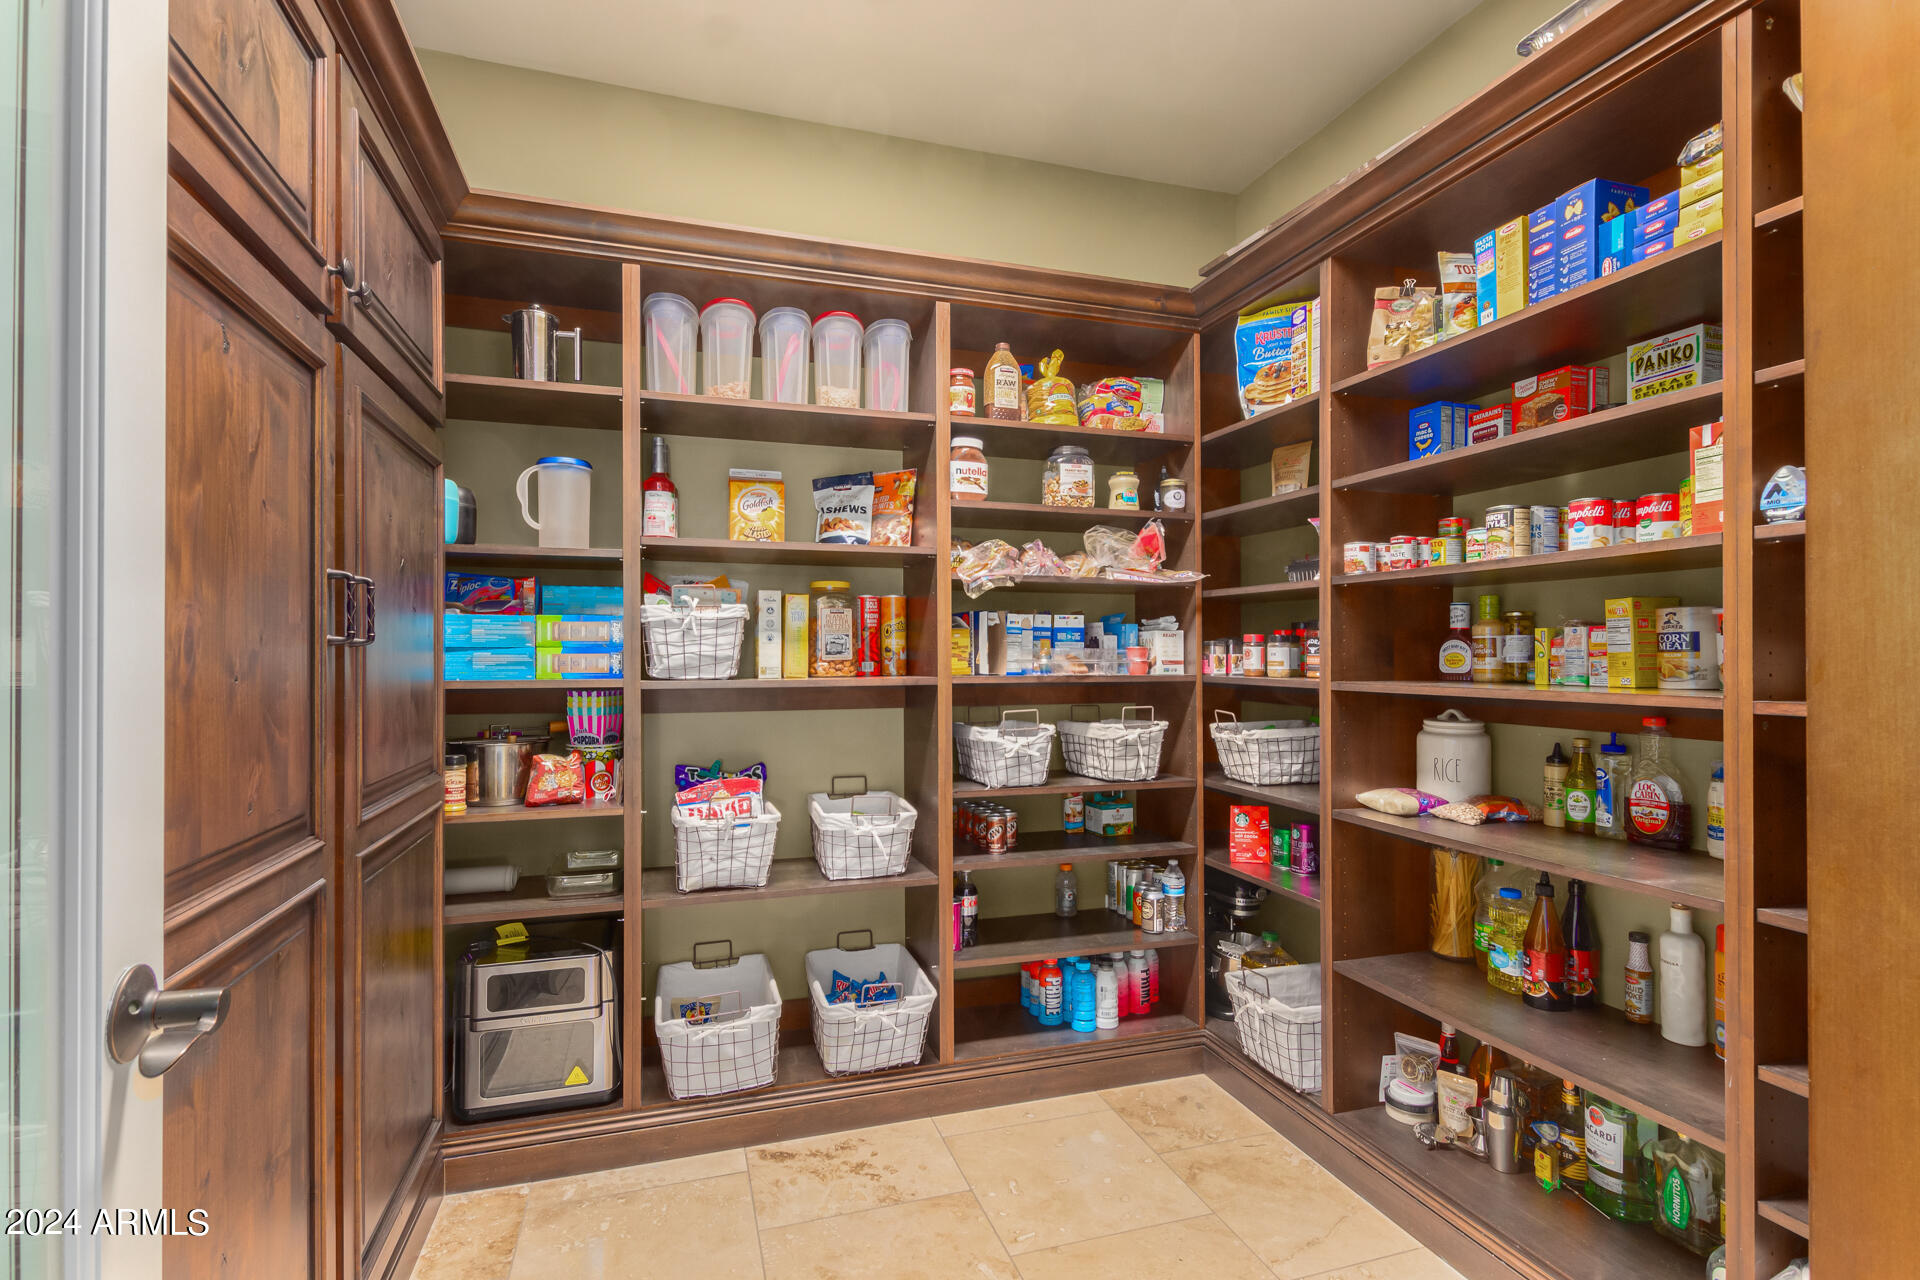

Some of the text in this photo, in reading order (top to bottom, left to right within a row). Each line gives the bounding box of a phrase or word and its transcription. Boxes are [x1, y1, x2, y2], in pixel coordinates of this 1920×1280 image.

[1476, 234, 1493, 247] PASTA
[1476, 240, 1493, 254] RONI
[1262, 308, 1284, 316] FAMILY
[1635, 343, 1695, 376] PANKO
[996, 378, 1016, 386] RAW
[1635, 373, 1693, 394] BREAD
[1635, 381, 1693, 400] CRUMBS
[956, 466, 988, 477] nutella
[742, 496, 774, 512] Goldfish
[450, 579, 482, 594] Ziploc
[1658, 632, 1690, 642] CORN
[1658, 641, 1690, 650] MEAL
[572, 736, 601, 744] POPCORN
[1433, 757, 1462, 783] RICE
[1638, 782, 1656, 793] LOG
[1634, 790, 1661, 800] CABIN
[1635, 816, 1662, 825] Original
[1140, 968, 1150, 1006] PRIME
[1045, 976, 1062, 1016] PRIME
[1672, 1177, 1681, 1224] HORNITOS
